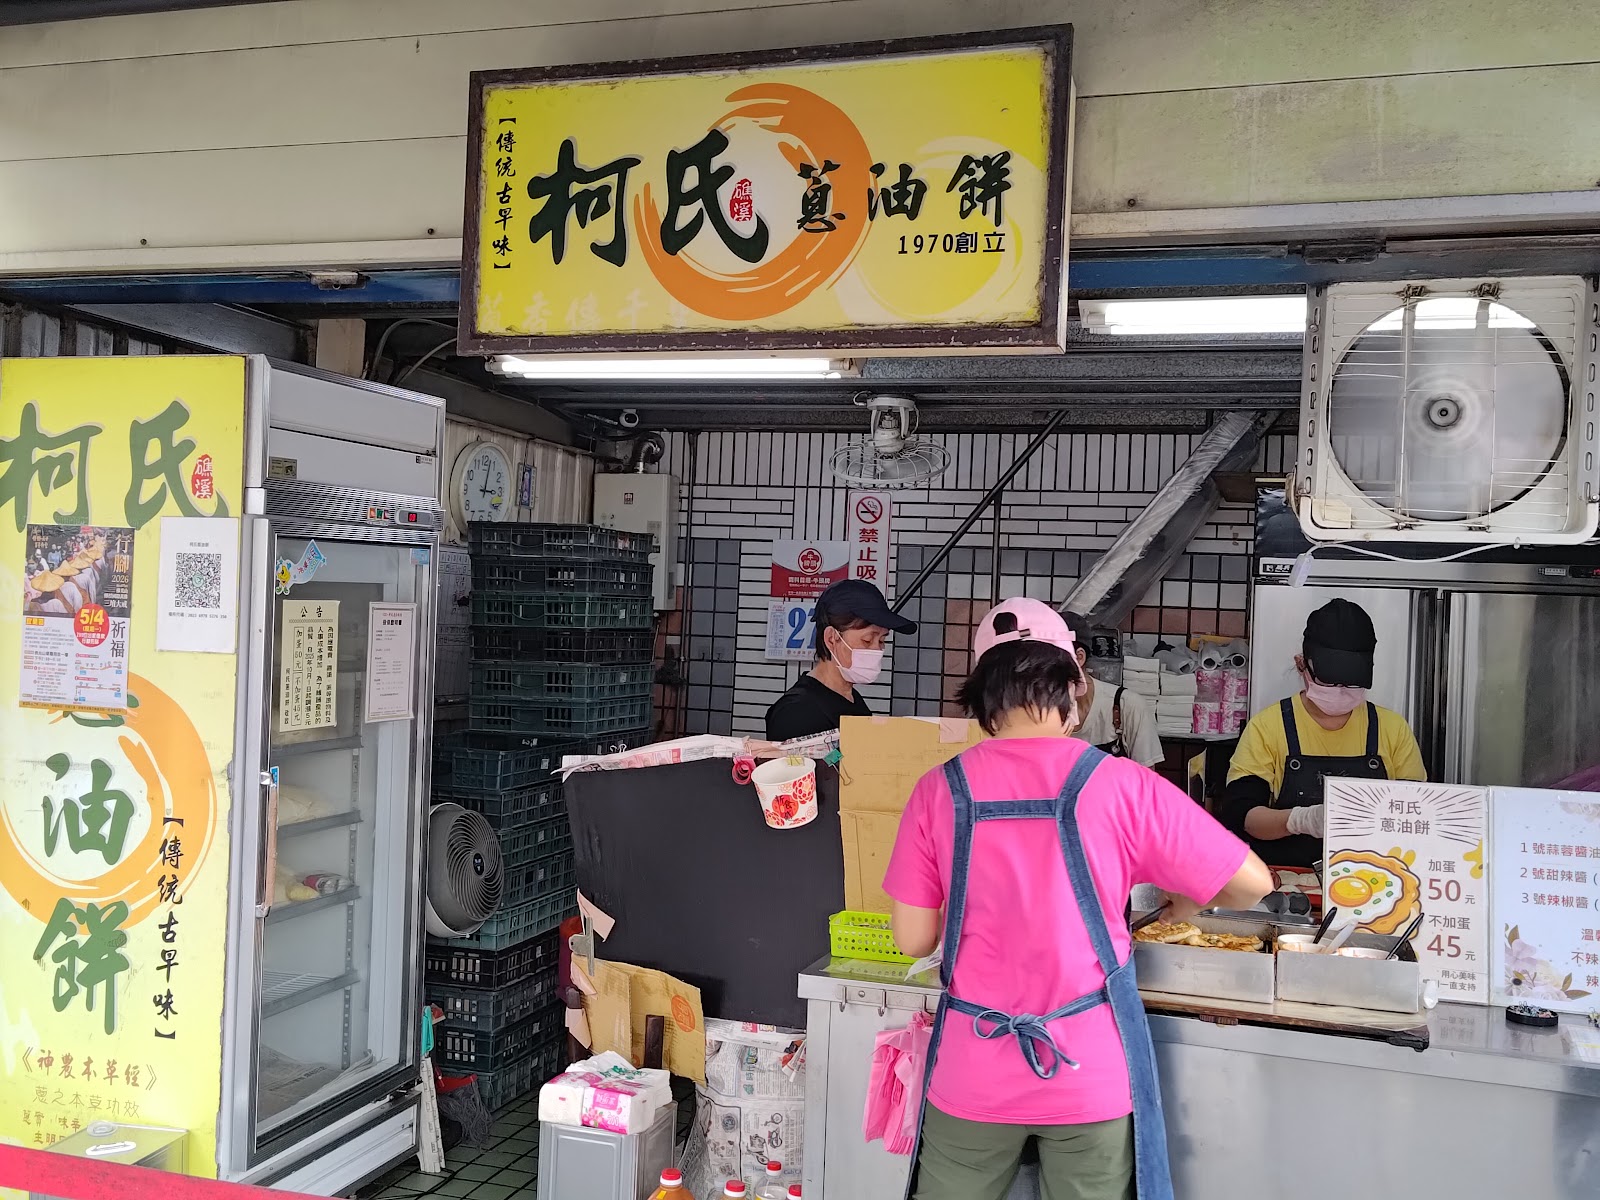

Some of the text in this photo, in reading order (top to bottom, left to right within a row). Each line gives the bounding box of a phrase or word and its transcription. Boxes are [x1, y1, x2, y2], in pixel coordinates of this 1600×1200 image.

[527, 129, 769, 267] 柯氏
[897, 231, 1007, 256] 1970創立
[0, 400, 230, 534] 柯氏
[481, 455, 489, 466] 12
[467, 469, 474, 481] 10
[496, 472, 502, 483] 2
[464, 484, 468, 495] 9
[497, 486, 503, 497] 3
[465, 500, 470, 511] 8
[112, 574, 129, 583] 2026
[79, 608, 105, 625] 5/4
[300, 605, 323, 618] 公告
[110, 620, 126, 658] 祈福
[1388, 799, 1422, 816] 柯氏
[1380, 817, 1430, 836] 蔥油餅
[33, 695, 140, 1036] 油餅
[1428, 859, 1456, 874] 加蛋
[1428, 878, 1475, 905] 50 元
[1428, 914, 1471, 931] 不加蛋
[1426, 934, 1476, 962] 45 元
[1571, 951, 1599, 966] 不辣
[1441, 969, 1477, 982] 用心美味
[22, 1046, 158, 1091] 《神農本草經》
